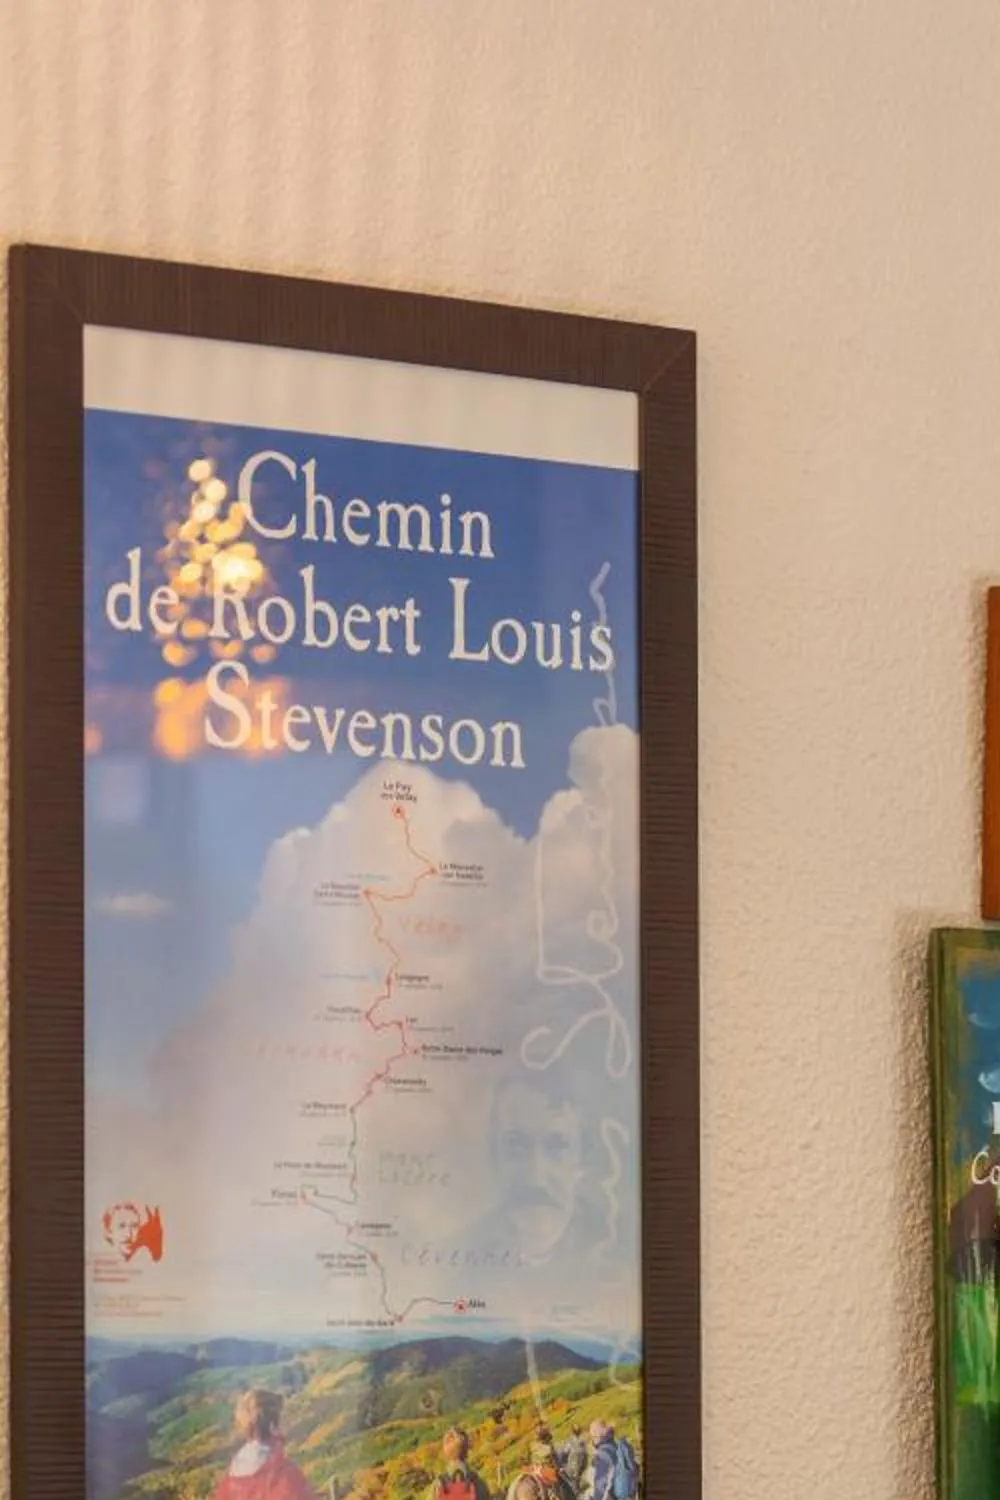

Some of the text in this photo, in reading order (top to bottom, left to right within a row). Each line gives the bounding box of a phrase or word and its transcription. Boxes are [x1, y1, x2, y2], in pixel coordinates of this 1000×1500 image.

[237, 450, 495, 559] Chemin
[105, 547, 615, 672] de Robert Louis
[204, 660, 527, 769] Stevenson
